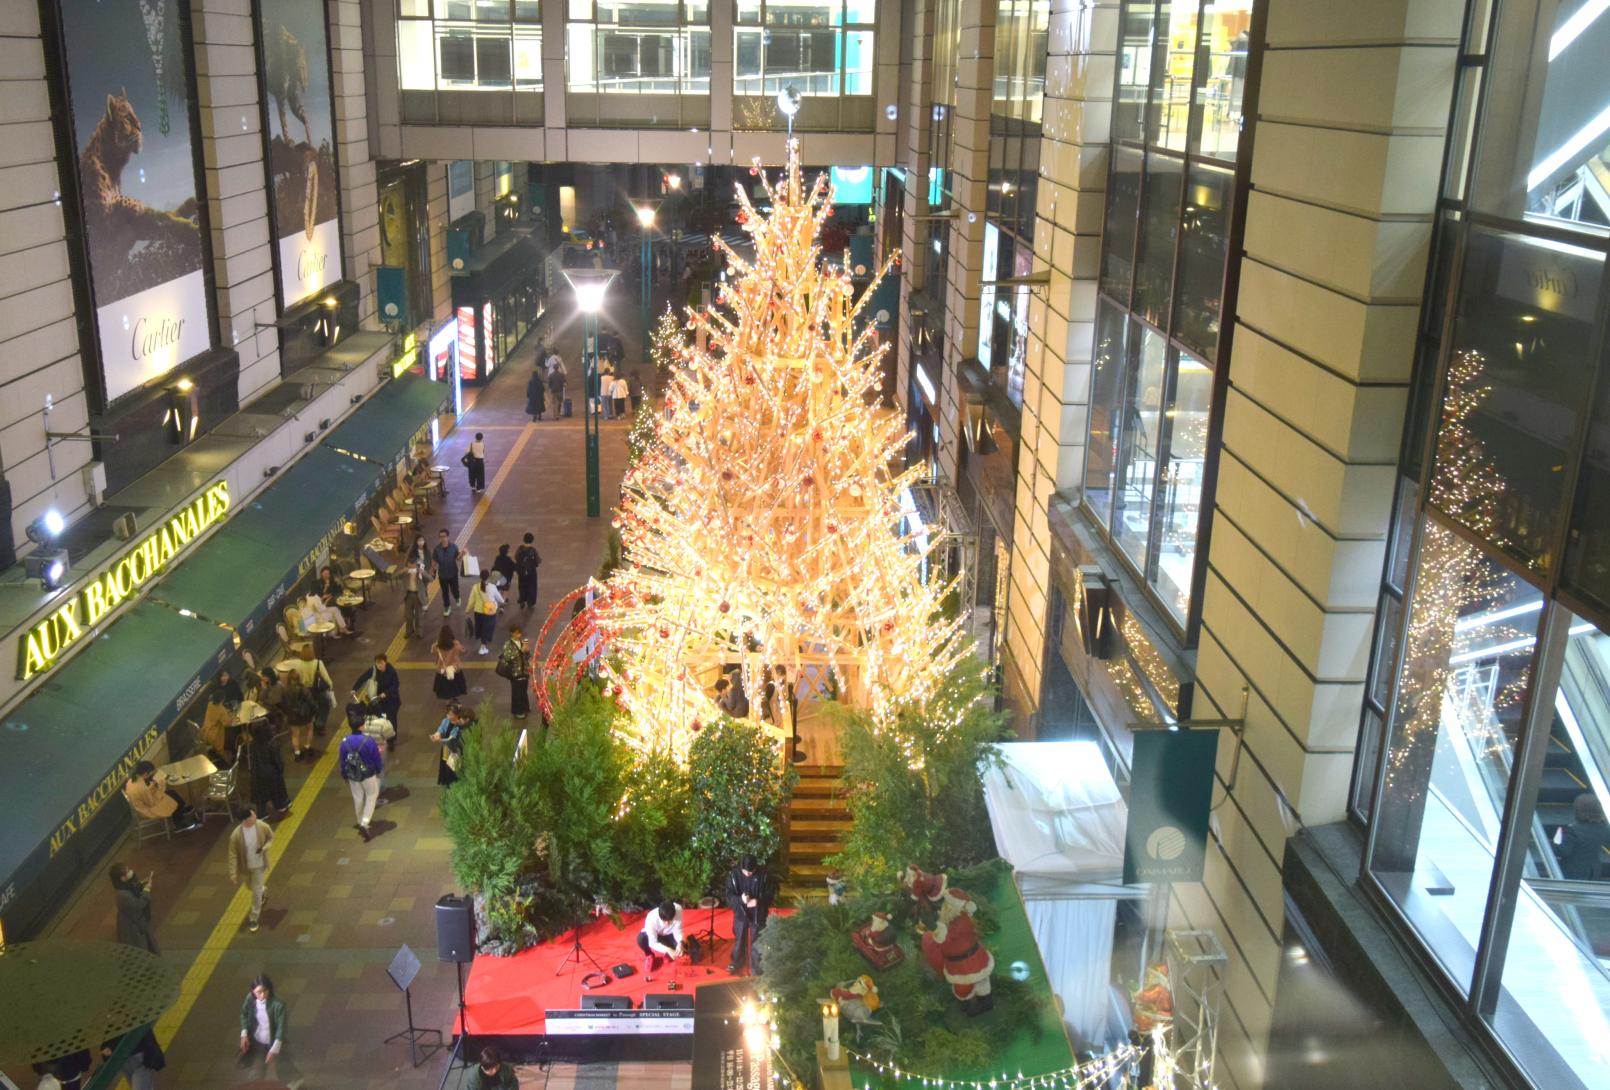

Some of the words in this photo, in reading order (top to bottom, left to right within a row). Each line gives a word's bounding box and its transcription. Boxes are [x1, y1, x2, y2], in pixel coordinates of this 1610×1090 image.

[297, 247, 328, 281] Cartier
[131, 317, 185, 361] Cartier
[20, 596, 82, 681] AUX
[83, 479, 229, 626] BACCHANALES
[49, 814, 78, 858] AUX
[78, 724, 158, 827] BACCHANALES
[747, 1054, 764, 1090] Passag
